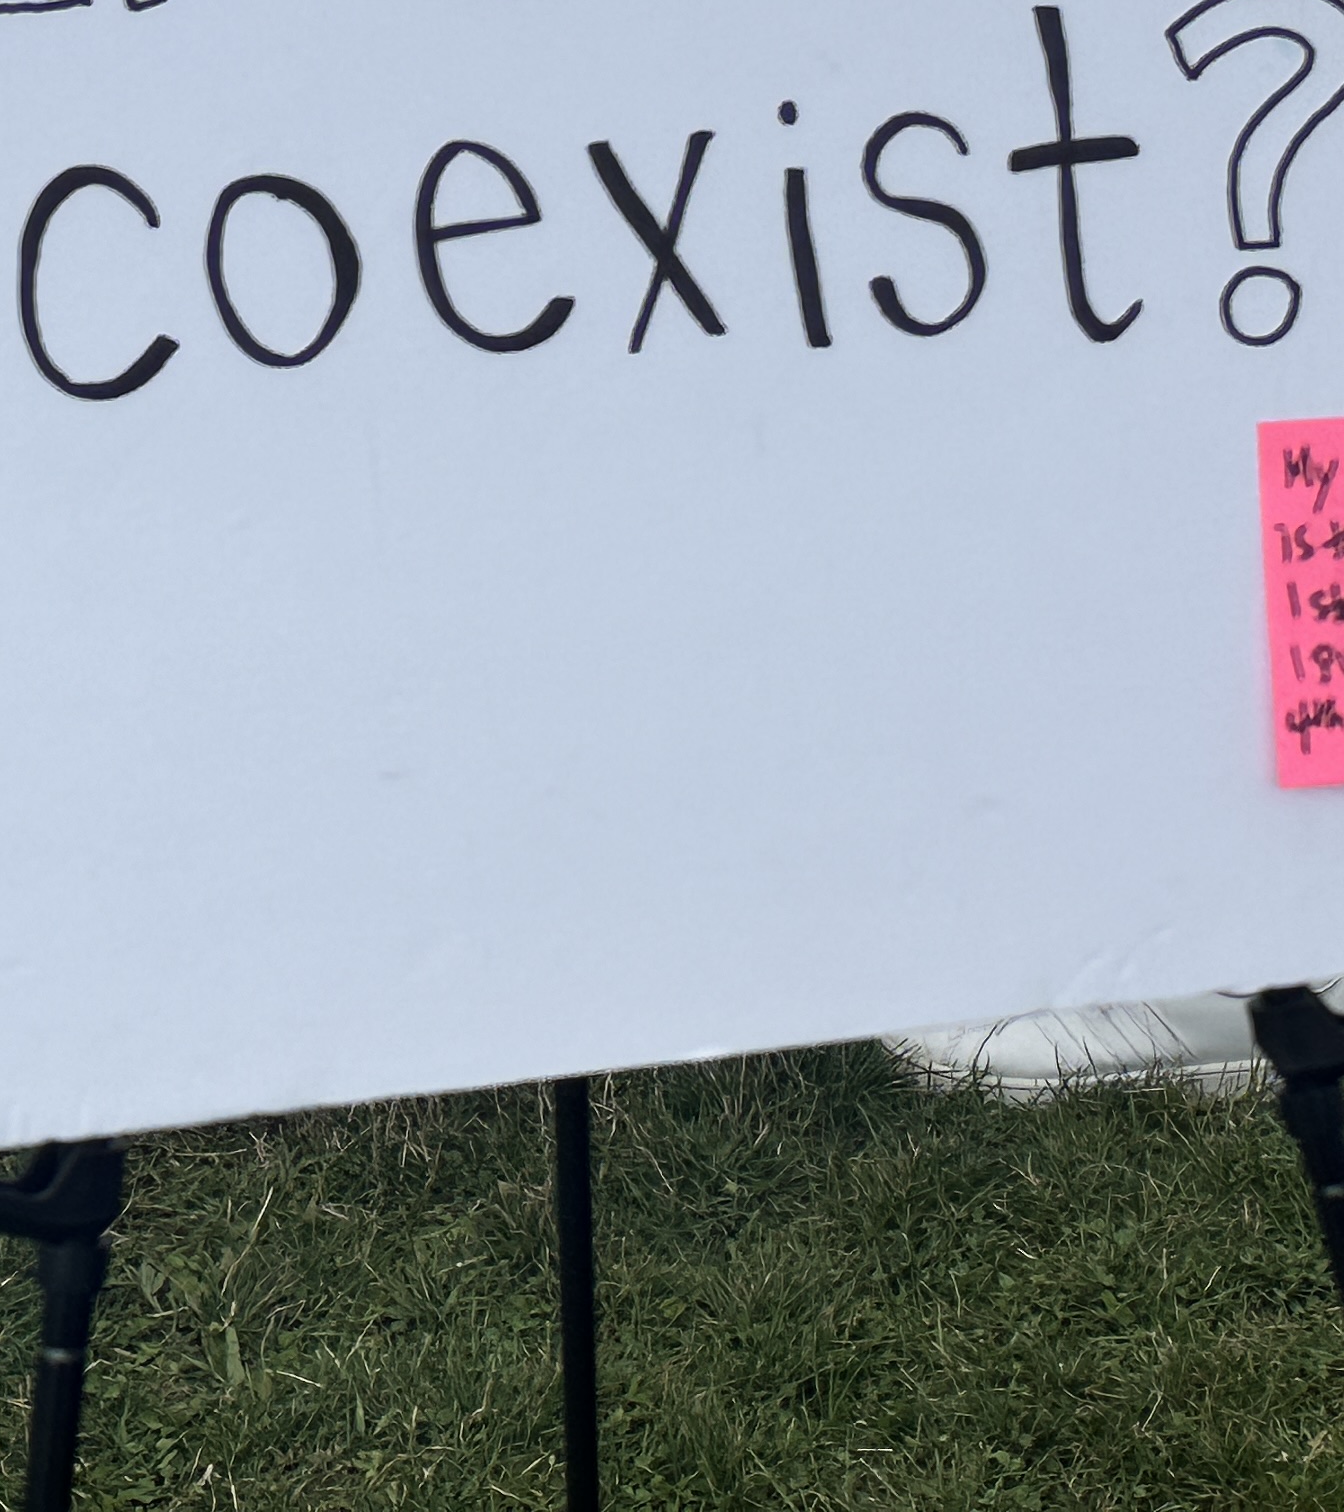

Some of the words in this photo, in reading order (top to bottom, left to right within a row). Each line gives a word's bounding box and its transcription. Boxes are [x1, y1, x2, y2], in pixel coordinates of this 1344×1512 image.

[1283, 443, 1339, 513] My
[1288, 581, 1301, 619] I
[1289, 644, 1305, 681] I
